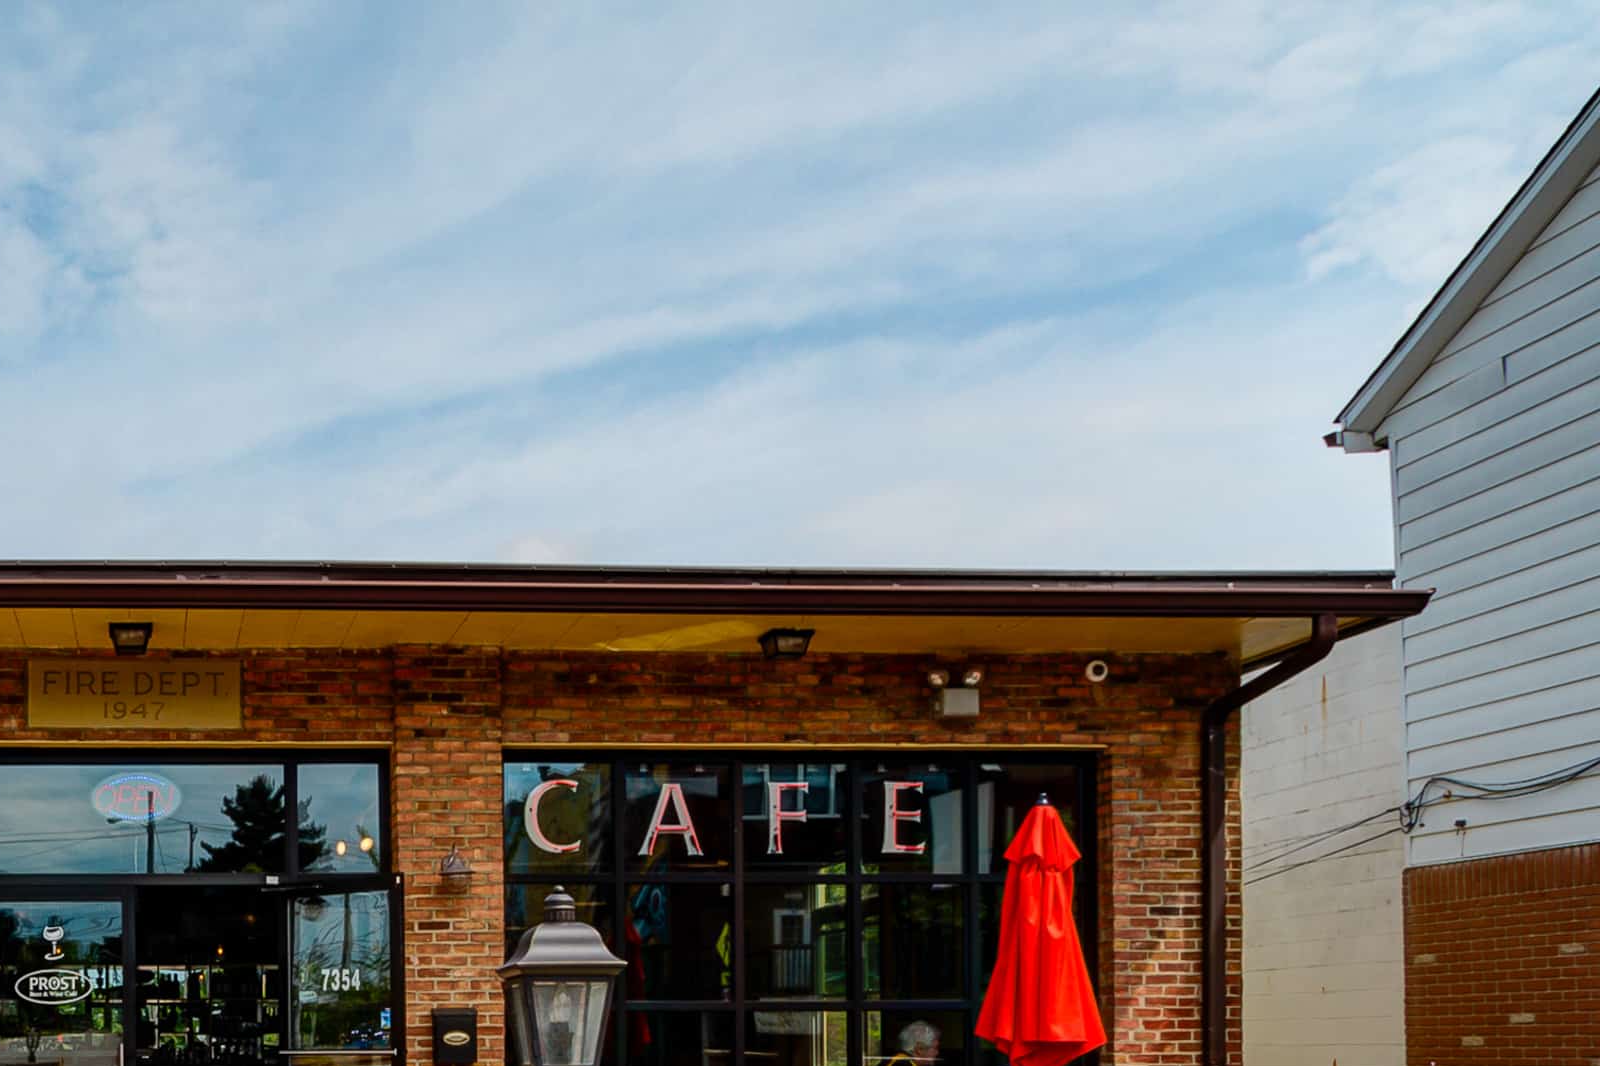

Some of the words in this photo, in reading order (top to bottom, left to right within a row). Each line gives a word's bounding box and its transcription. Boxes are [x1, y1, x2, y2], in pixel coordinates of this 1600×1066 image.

[41, 669, 120, 696] FIRE
[133, 670, 231, 697] DEPT.
[103, 701, 166, 721] 1947
[95, 783, 175, 816] OPEN
[523, 779, 928, 857] CAFE
[29, 976, 79, 990] PROST
[321, 968, 361, 991] 7354
